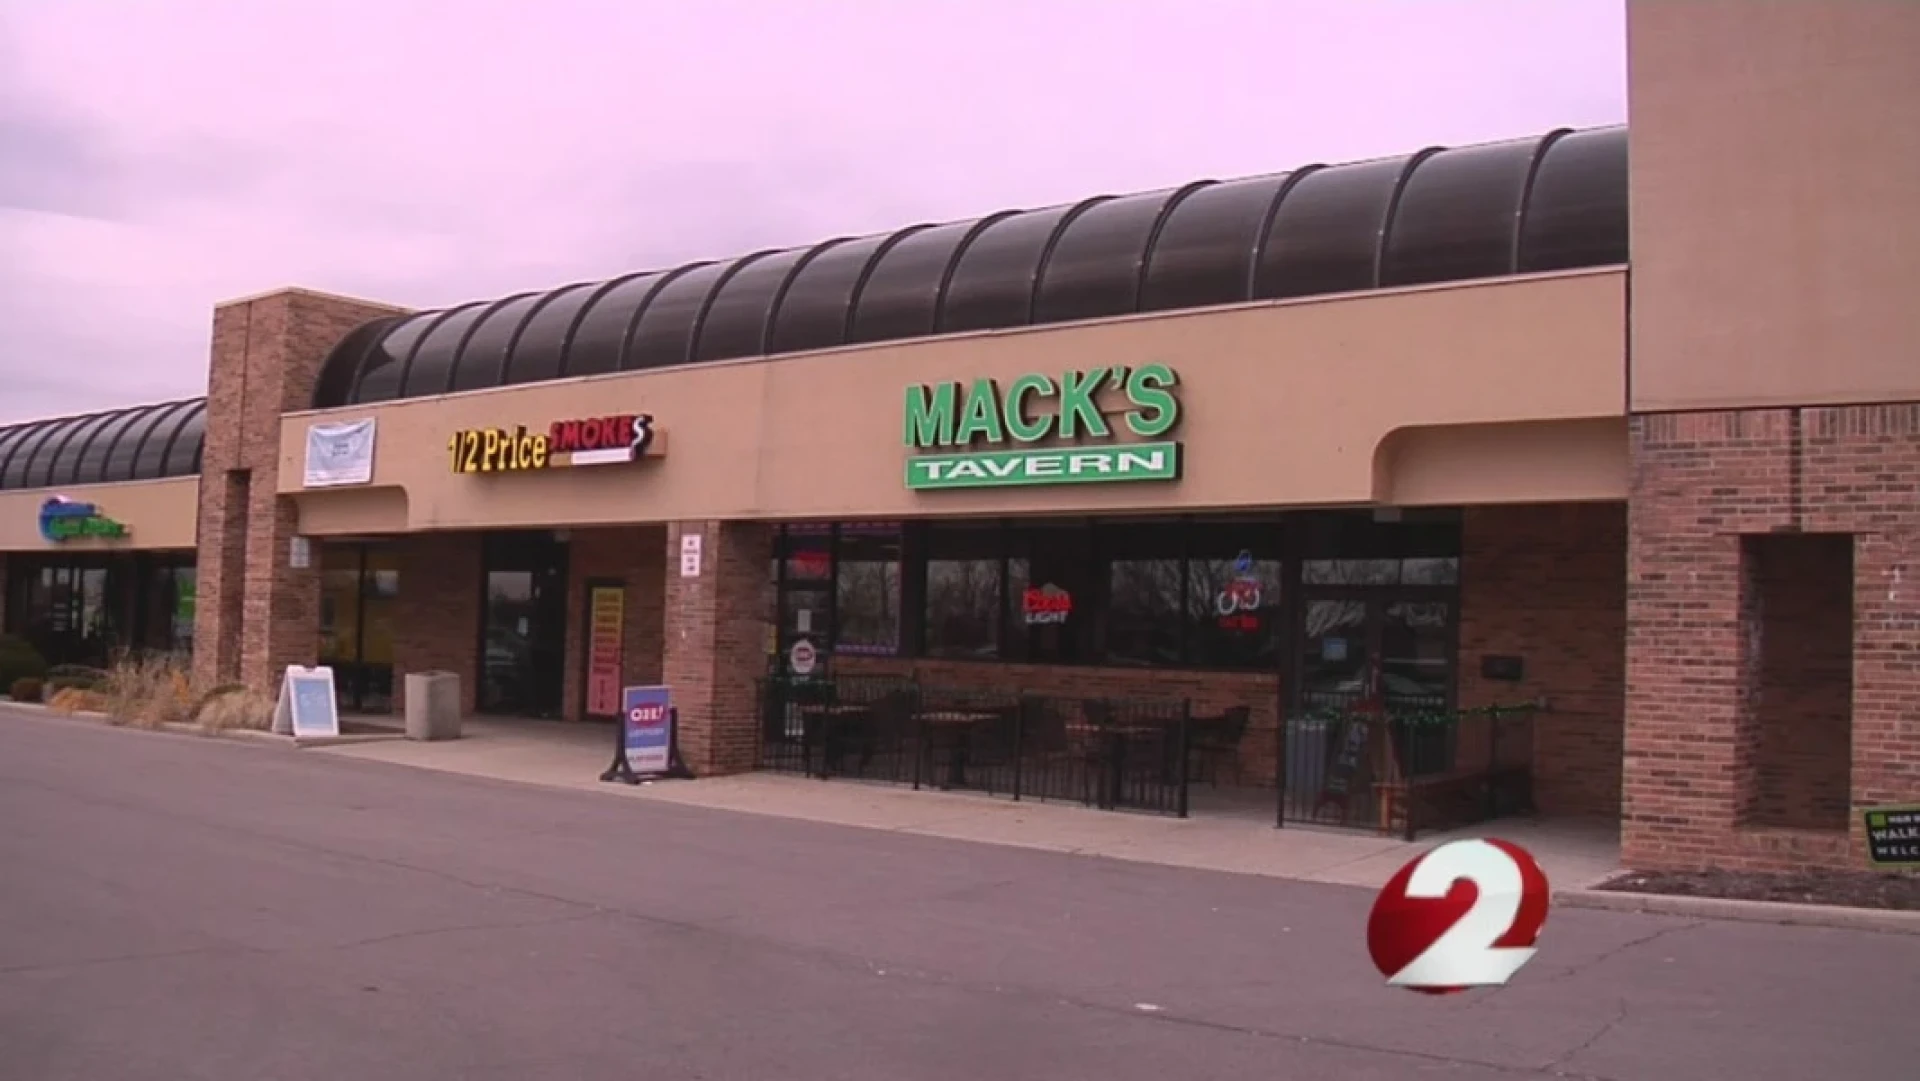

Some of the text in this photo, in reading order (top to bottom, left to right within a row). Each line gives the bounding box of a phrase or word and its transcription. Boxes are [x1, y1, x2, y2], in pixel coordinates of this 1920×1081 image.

[905, 363, 1177, 447] MACK'S
[482, 426, 546, 472] Price
[551, 415, 653, 449] SMOKES
[914, 451, 1165, 480] TAVERN
